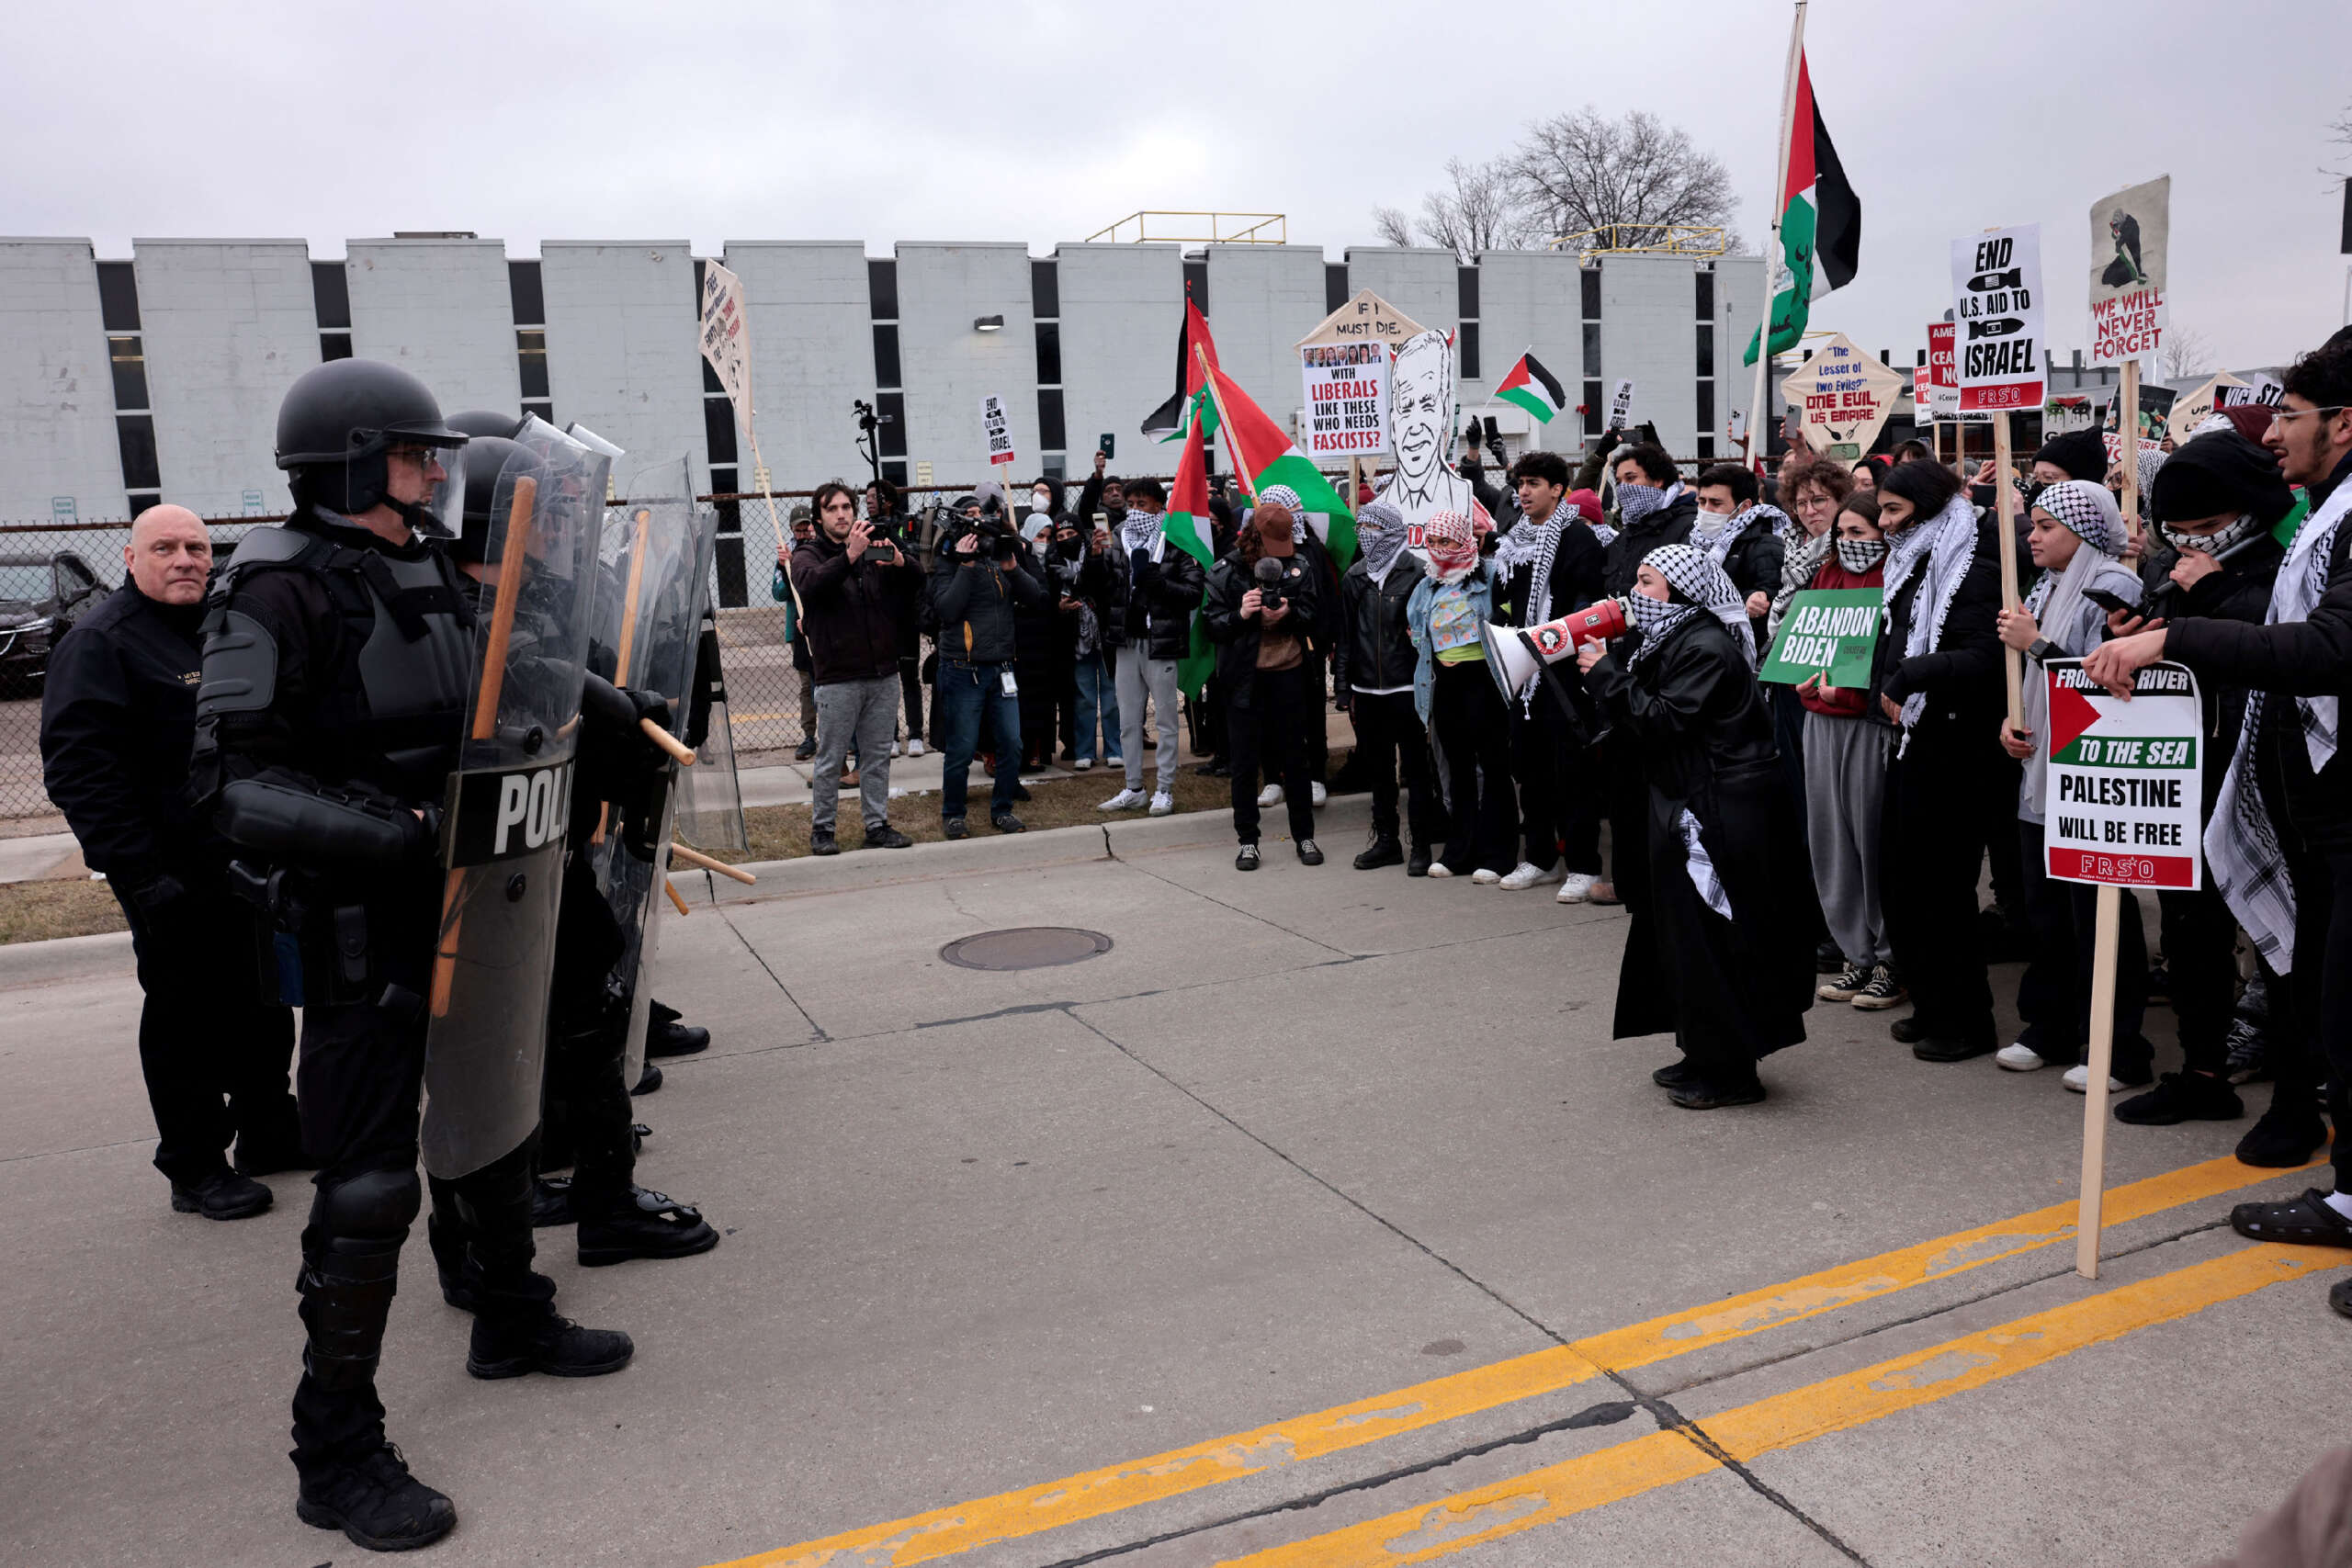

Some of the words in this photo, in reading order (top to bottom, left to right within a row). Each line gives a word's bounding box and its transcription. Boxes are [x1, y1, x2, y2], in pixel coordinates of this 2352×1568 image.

[1975, 237, 2013, 273] END
[1358, 302, 1368, 315] IF
[1374, 303, 1378, 315] I
[1960, 296, 1983, 319] U.S.
[1986, 292, 2007, 315] AID
[2012, 288, 2030, 311] TO
[2092, 298, 2116, 321] WE
[2121, 287, 2163, 313] WILL
[1337, 323, 1370, 336] MUST
[1376, 321, 1401, 335] DIE.
[2098, 309, 2155, 340] NEVER
[2093, 328, 2162, 361] FORGET
[1818, 363, 1849, 376] Lesser
[1853, 361, 1861, 374] of
[1931, 351, 1955, 366] CEA
[1964, 338, 2036, 378] ISRAEL
[1331, 367, 1356, 380] WITH
[1312, 379, 1378, 401] LIBERALS
[1815, 381, 1833, 393] two
[986, 397, 997, 411] END
[1315, 402, 1338, 416] LIKE
[1343, 400, 1376, 414] THESE
[1805, 393, 1837, 410] ONE
[1314, 417, 1340, 431] WHO
[1345, 414, 1379, 429] NEEDS
[1810, 412, 1826, 423] US
[1830, 409, 1875, 423] EMPIRE
[990, 434, 1012, 452] ISRAEL
[1313, 431, 1381, 451] FASCISTS?
[1790, 605, 1878, 637] ABANDON
[1779, 634, 1838, 668] BIDEN
[2136, 669, 2188, 691] RIVER
[2079, 739, 2101, 762] TO
[2105, 740, 2143, 765] THE
[2146, 741, 2189, 765] SEA
[2060, 773, 2182, 808] PALESTINE
[493, 760, 576, 854] POLI
[2058, 816, 2098, 841] WILL
[2104, 820, 2127, 843] BE
[2134, 822, 2182, 846] FREE
[2081, 854, 2154, 879] FRSO
